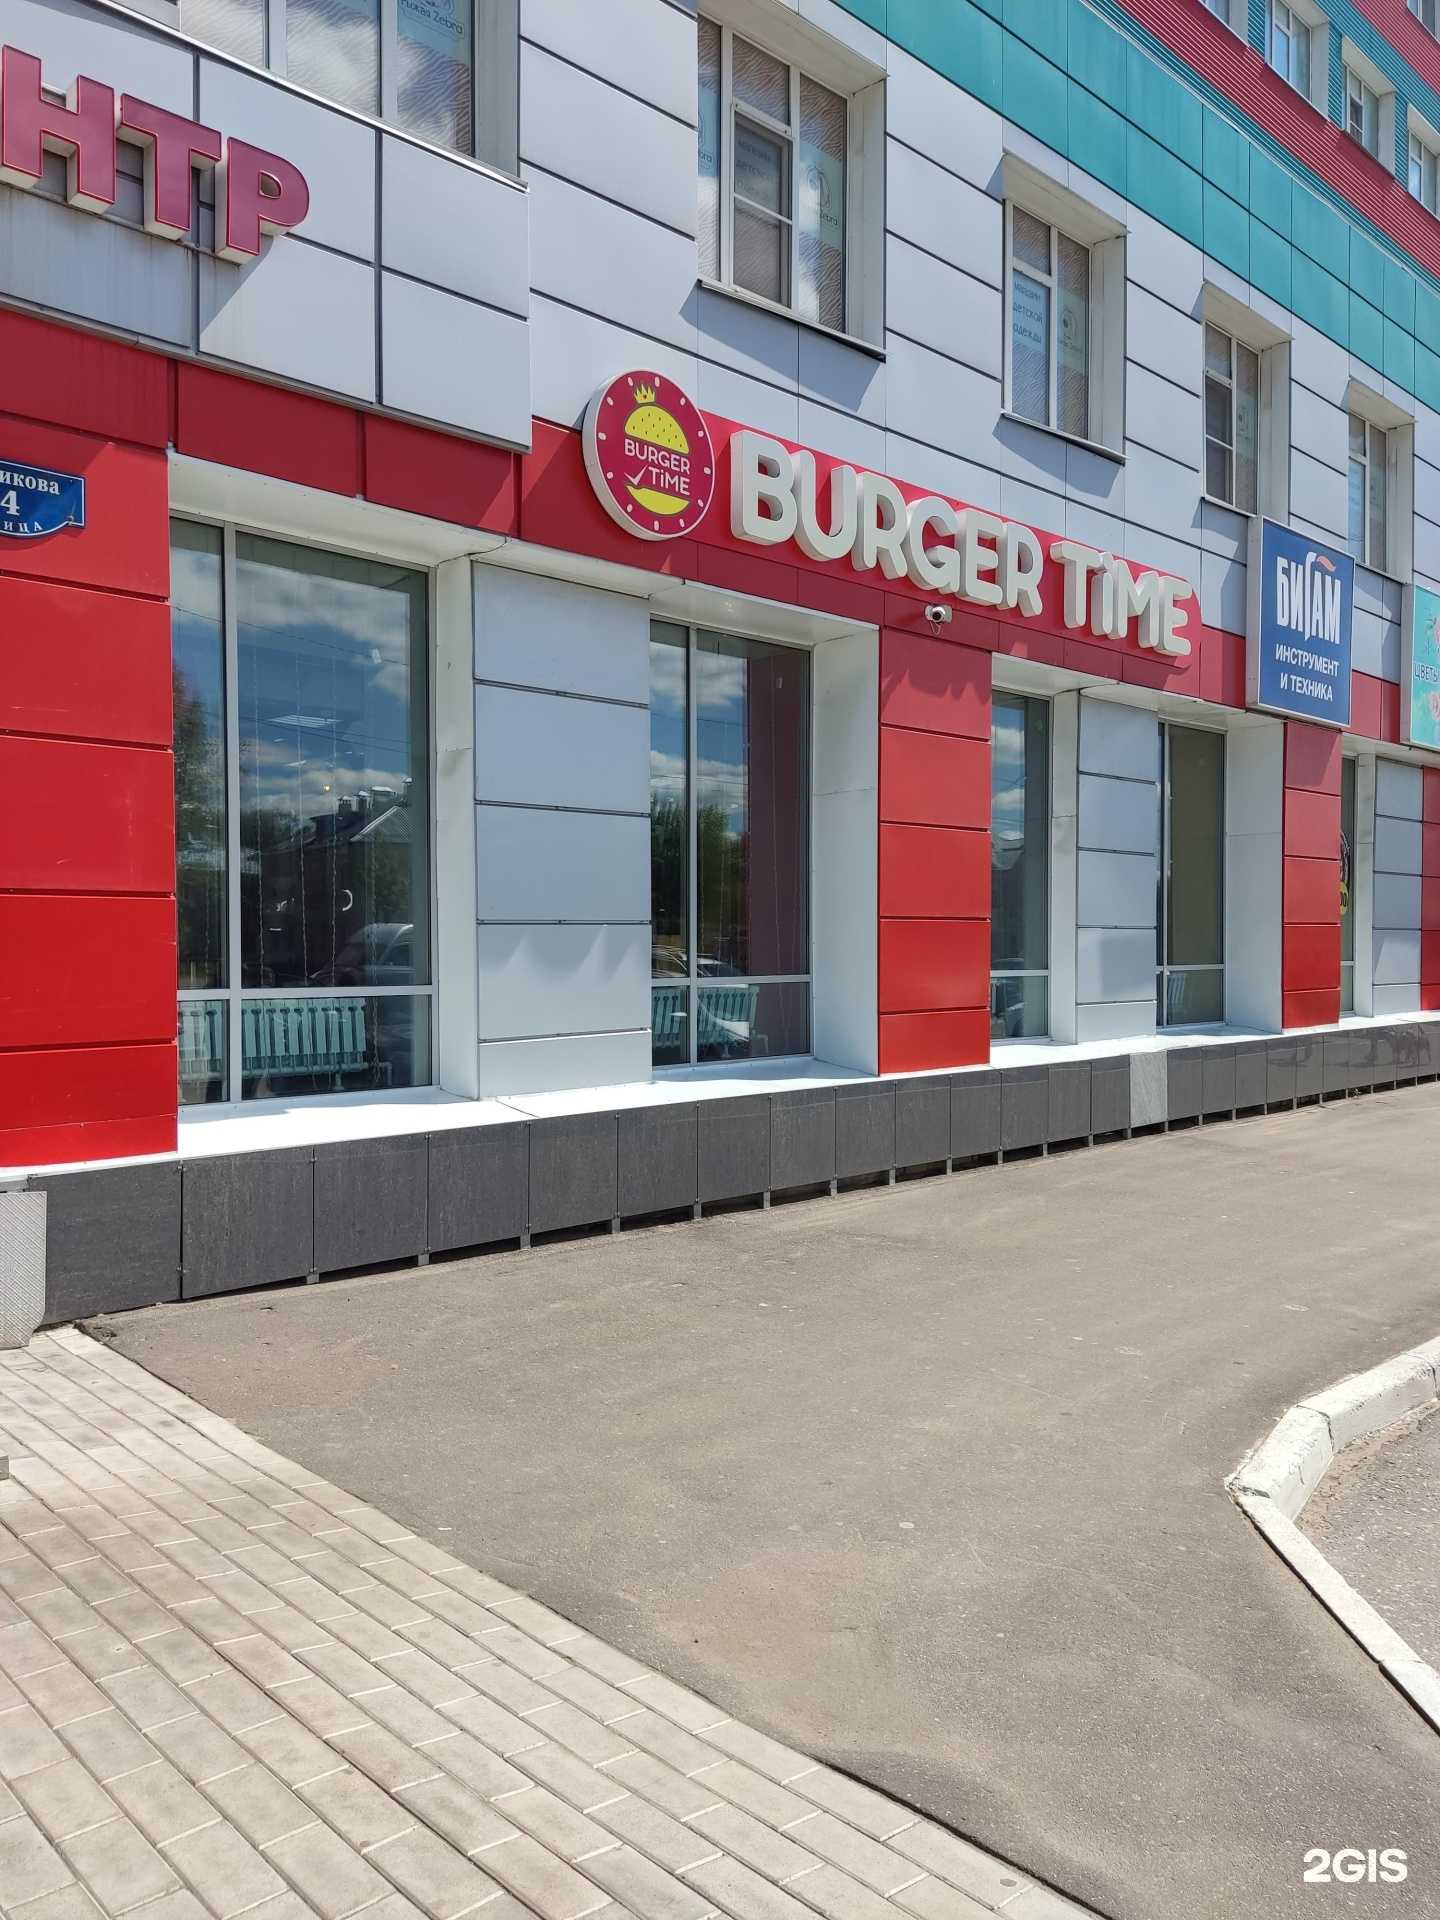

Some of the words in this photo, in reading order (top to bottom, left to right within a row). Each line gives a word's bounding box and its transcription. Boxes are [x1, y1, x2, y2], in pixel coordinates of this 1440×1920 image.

[433, 10, 463, 34] Zebra
[1, 44, 309, 260] НТР
[624, 438, 690, 475] BURGER
[0, 490, 20, 516] 4
[730, 430, 1043, 618] BURGER
[1277, 551, 1340, 644] БИГАМ
[1275, 643, 1340, 677] ИНСТРУМЕНТ
[1280, 671, 1289, 690] И
[1290, 675, 1334, 702] ТЕХНИКА
